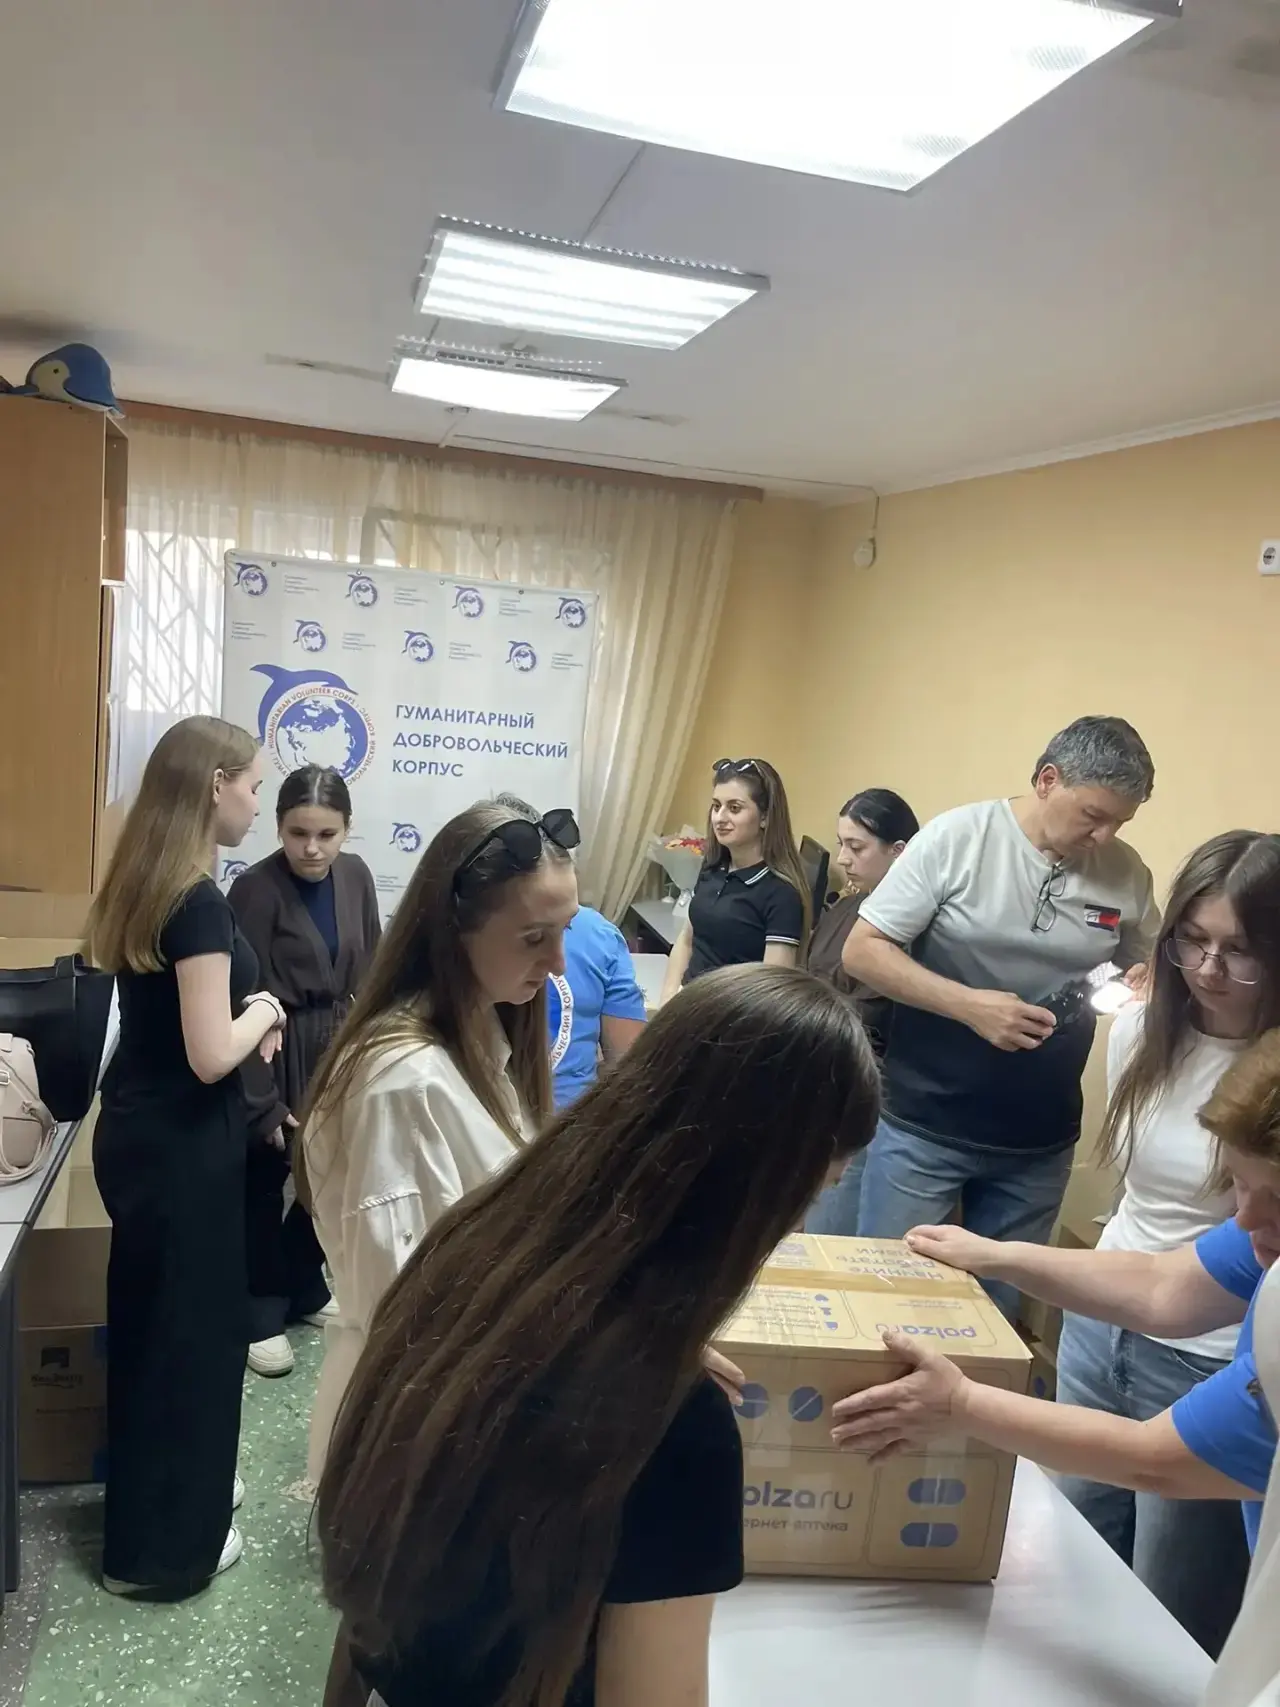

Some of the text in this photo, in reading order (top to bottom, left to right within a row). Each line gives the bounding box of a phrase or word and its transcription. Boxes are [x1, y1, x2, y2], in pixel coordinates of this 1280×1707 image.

[396, 704, 535, 729] ГУМАНИТАРНЫЙ
[393, 731, 568, 758] ДОБРОВОЛЬЧЕСКИЙ
[346, 741, 377, 786] ОВОЛЬЧЕСКИЙ
[392, 758, 464, 777] КОРПУС
[552, 1015, 570, 1064] ЛЬЧЕСКИЙ
[743, 1480, 853, 1511] olzaru
[743, 1517, 849, 1532] ернет аптека
